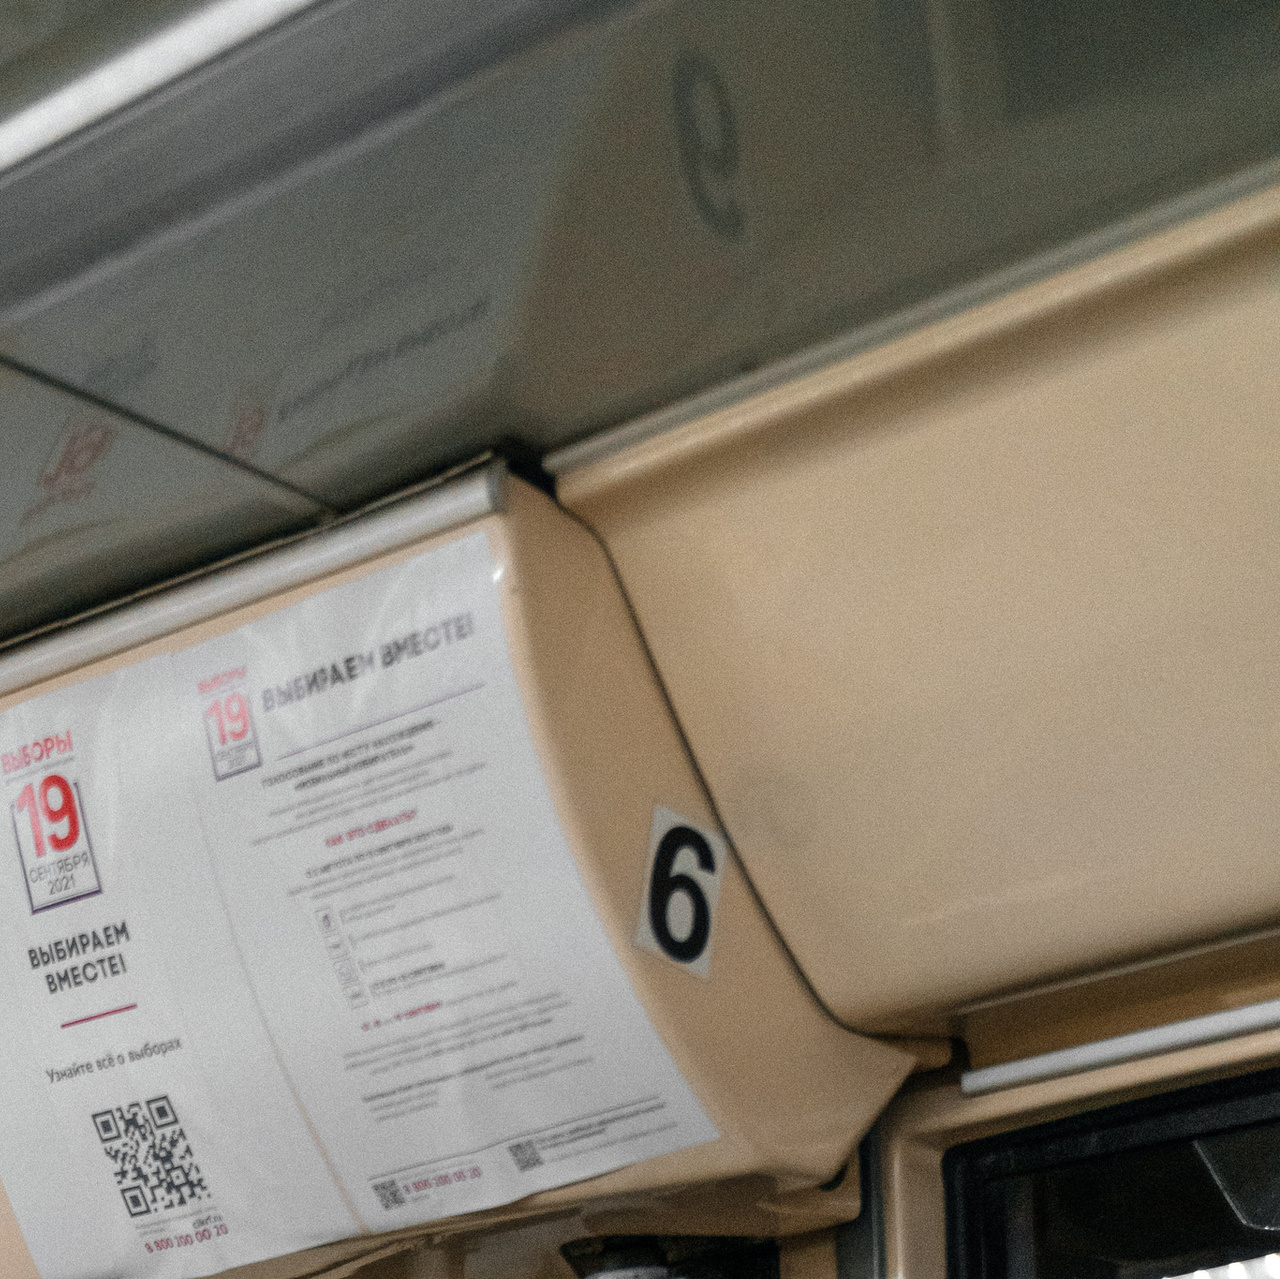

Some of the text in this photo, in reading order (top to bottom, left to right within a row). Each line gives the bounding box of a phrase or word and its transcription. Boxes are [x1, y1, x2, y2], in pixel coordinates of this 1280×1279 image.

[206, 693, 248, 745] 19
[1, 731, 74, 774] ВЫБОРЫ
[16, 774, 79, 858] 19
[29, 852, 91, 884] СЕНТЯБРЯ
[48, 876, 77, 896] 2021
[649, 825, 716, 964] 6
[28, 920, 131, 970] ВЫБИРАЕМ
[45, 953, 127, 995] ВМЕСТЕ!
[45, 1037, 183, 1084] Узнайте всё о выборах
[144, 1242, 154, 1254] 8
[153, 1237, 174, 1251] 800
[195, 1228, 212, 1242] 00
